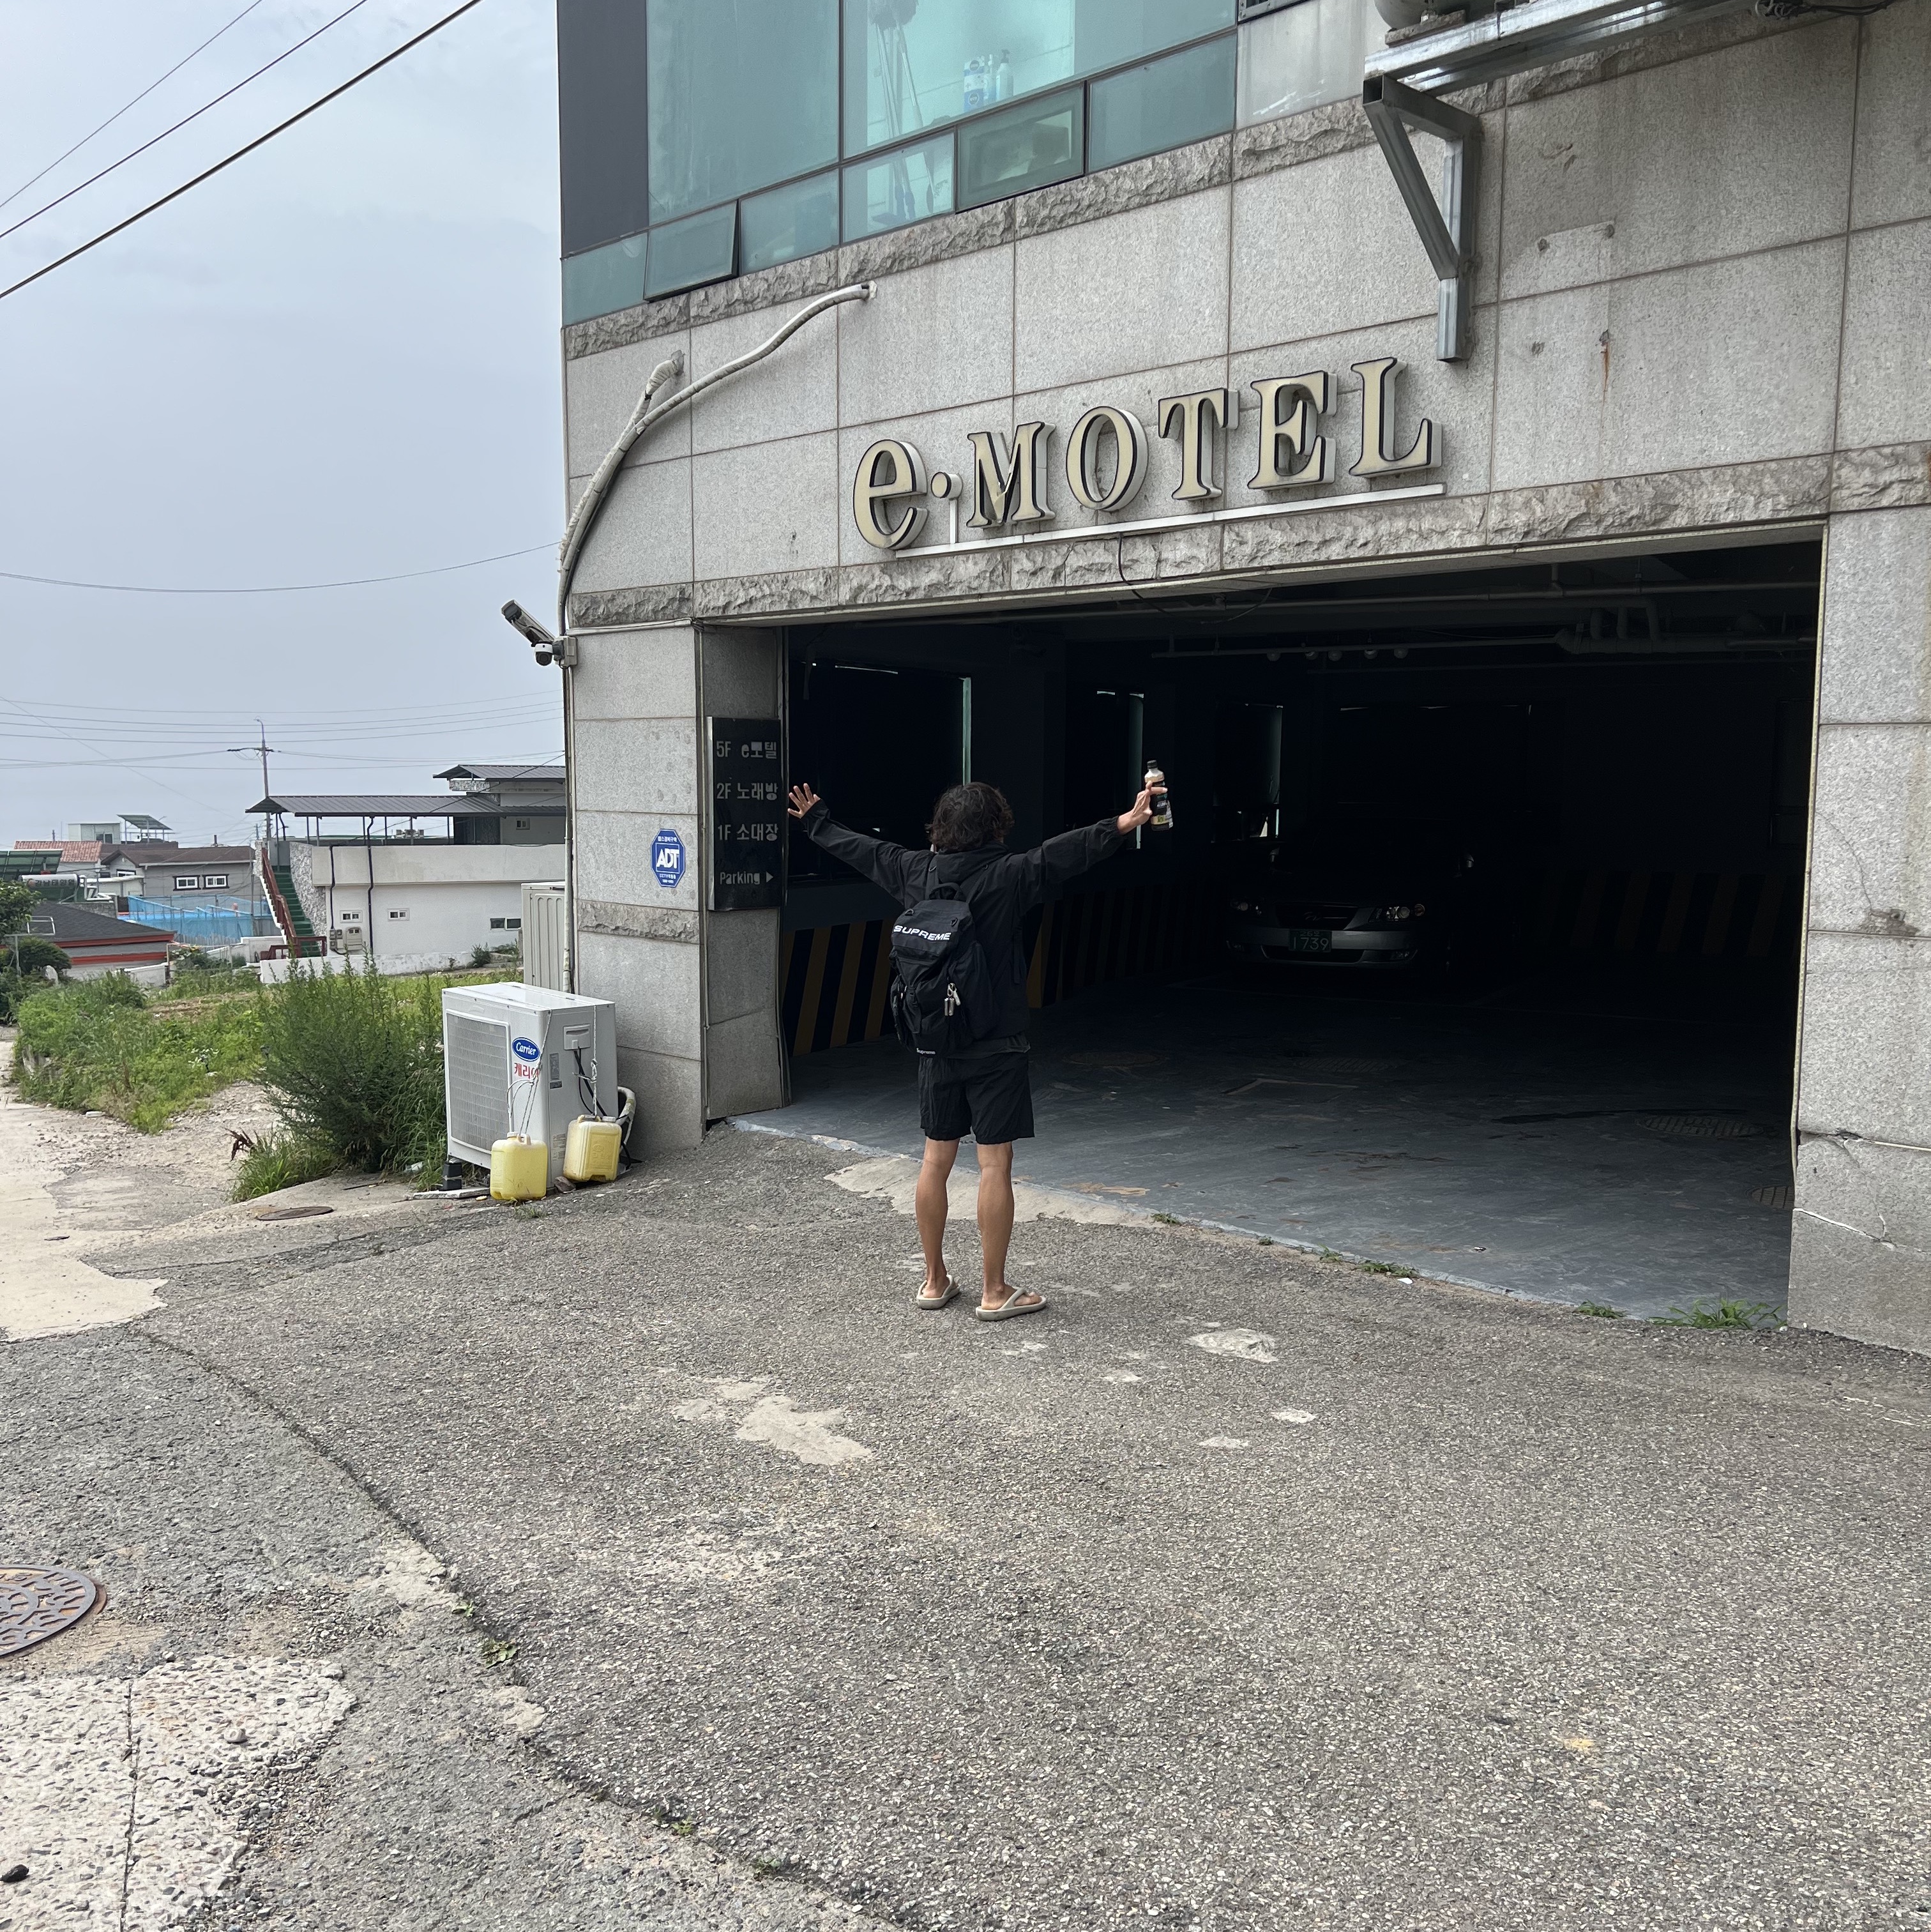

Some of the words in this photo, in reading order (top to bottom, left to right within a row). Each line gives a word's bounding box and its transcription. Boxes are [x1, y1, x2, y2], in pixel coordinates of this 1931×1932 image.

[716, 741, 731, 758] 5F
[716, 782, 731, 799] 2F
[737, 782, 778, 801] 노래방
[718, 824, 731, 840] 1F
[736, 823, 779, 841] 소대장
[656, 848, 680, 869] ADT
[720, 871, 761, 886] Parking
[894, 925, 951, 941] SUPREME
[1294, 936, 1329, 950] 1739
[515, 1042, 536, 1056] Carrier
